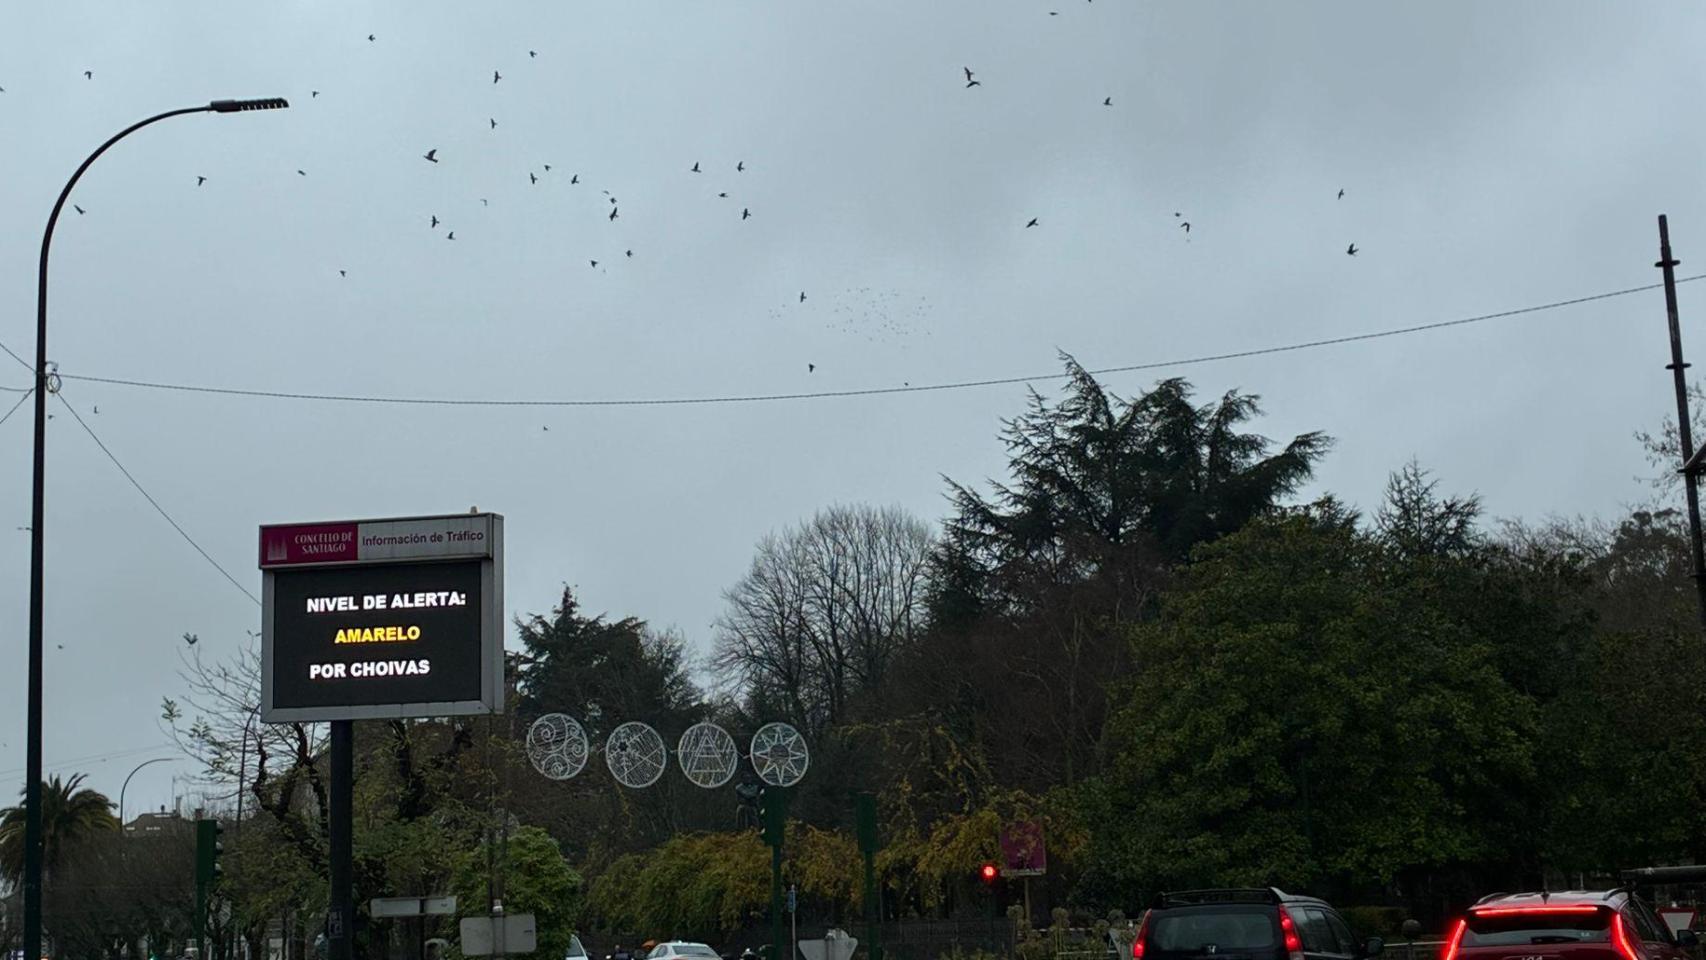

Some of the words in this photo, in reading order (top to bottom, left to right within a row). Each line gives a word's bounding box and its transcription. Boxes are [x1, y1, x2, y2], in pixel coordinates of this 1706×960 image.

[294, 532, 340, 544] CONCELLO
[341, 531, 352, 542] DE
[362, 533, 427, 546] Información
[429, 531, 444, 543] de
[446, 530, 484, 542] Tráfico
[302, 543, 346, 554] SANTIAGO
[306, 596, 359, 613] NIVEL
[363, 595, 387, 610] DE
[391, 591, 466, 608] ALERTA:
[334, 626, 421, 643] AMARELO
[309, 663, 346, 680] POR
[350, 660, 431, 677] CHOIVAS
